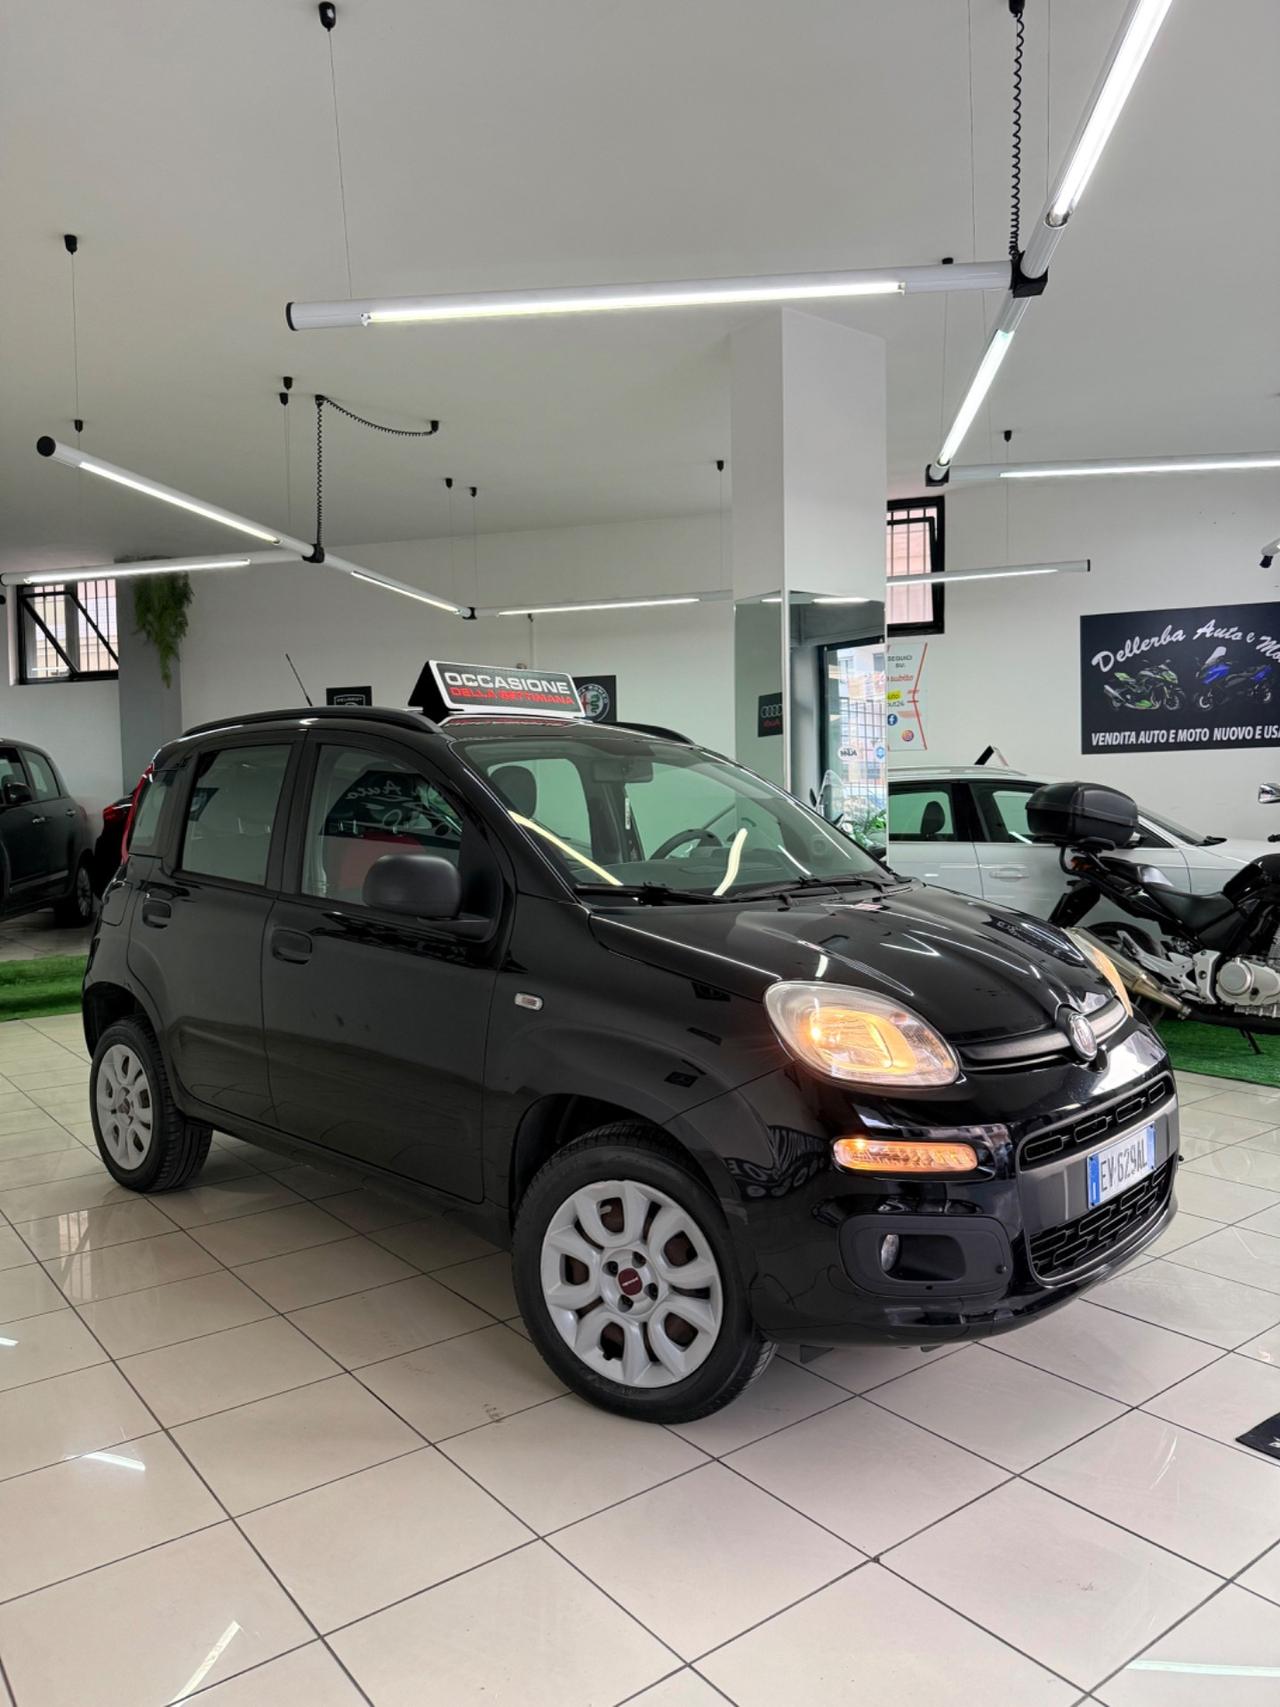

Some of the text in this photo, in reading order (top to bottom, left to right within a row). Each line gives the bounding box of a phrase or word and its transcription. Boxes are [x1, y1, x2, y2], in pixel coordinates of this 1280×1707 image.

[1091, 625, 1186, 672] Dellerba
[1193, 619, 1242, 641] Auto
[1246, 632, 1256, 643] e
[444, 672, 571, 695] OCCASIONE
[449, 687, 497, 699] DELLA
[1092, 725, 1280, 746] VENDITA AUTO E MOTO NUOVO E US
